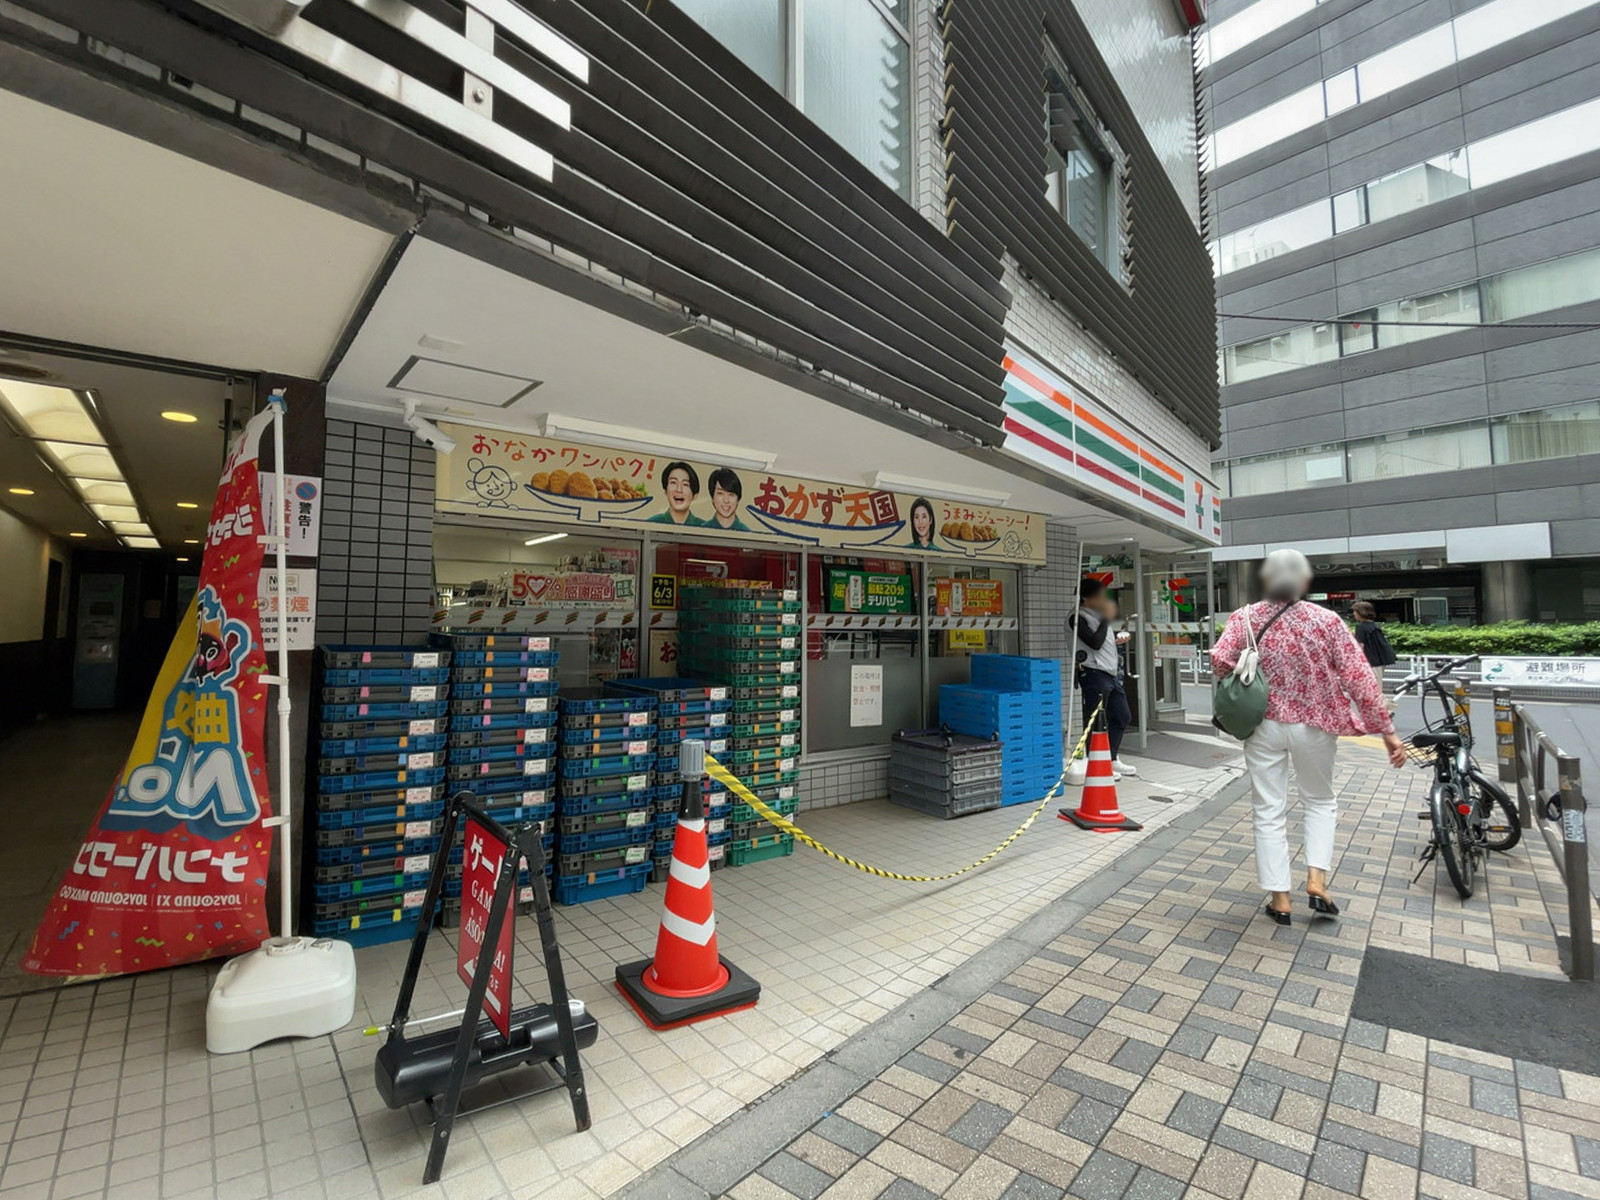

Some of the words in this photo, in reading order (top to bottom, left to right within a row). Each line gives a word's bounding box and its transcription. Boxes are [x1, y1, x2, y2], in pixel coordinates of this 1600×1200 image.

[471, 434, 656, 480] おなかワンパク!
[754, 476, 901, 527] おかず天国
[941, 502, 1031, 531] うまみジューシー!
[653, 587, 673, 599] 6/3
[1525, 662, 1586, 674] 避難場所
